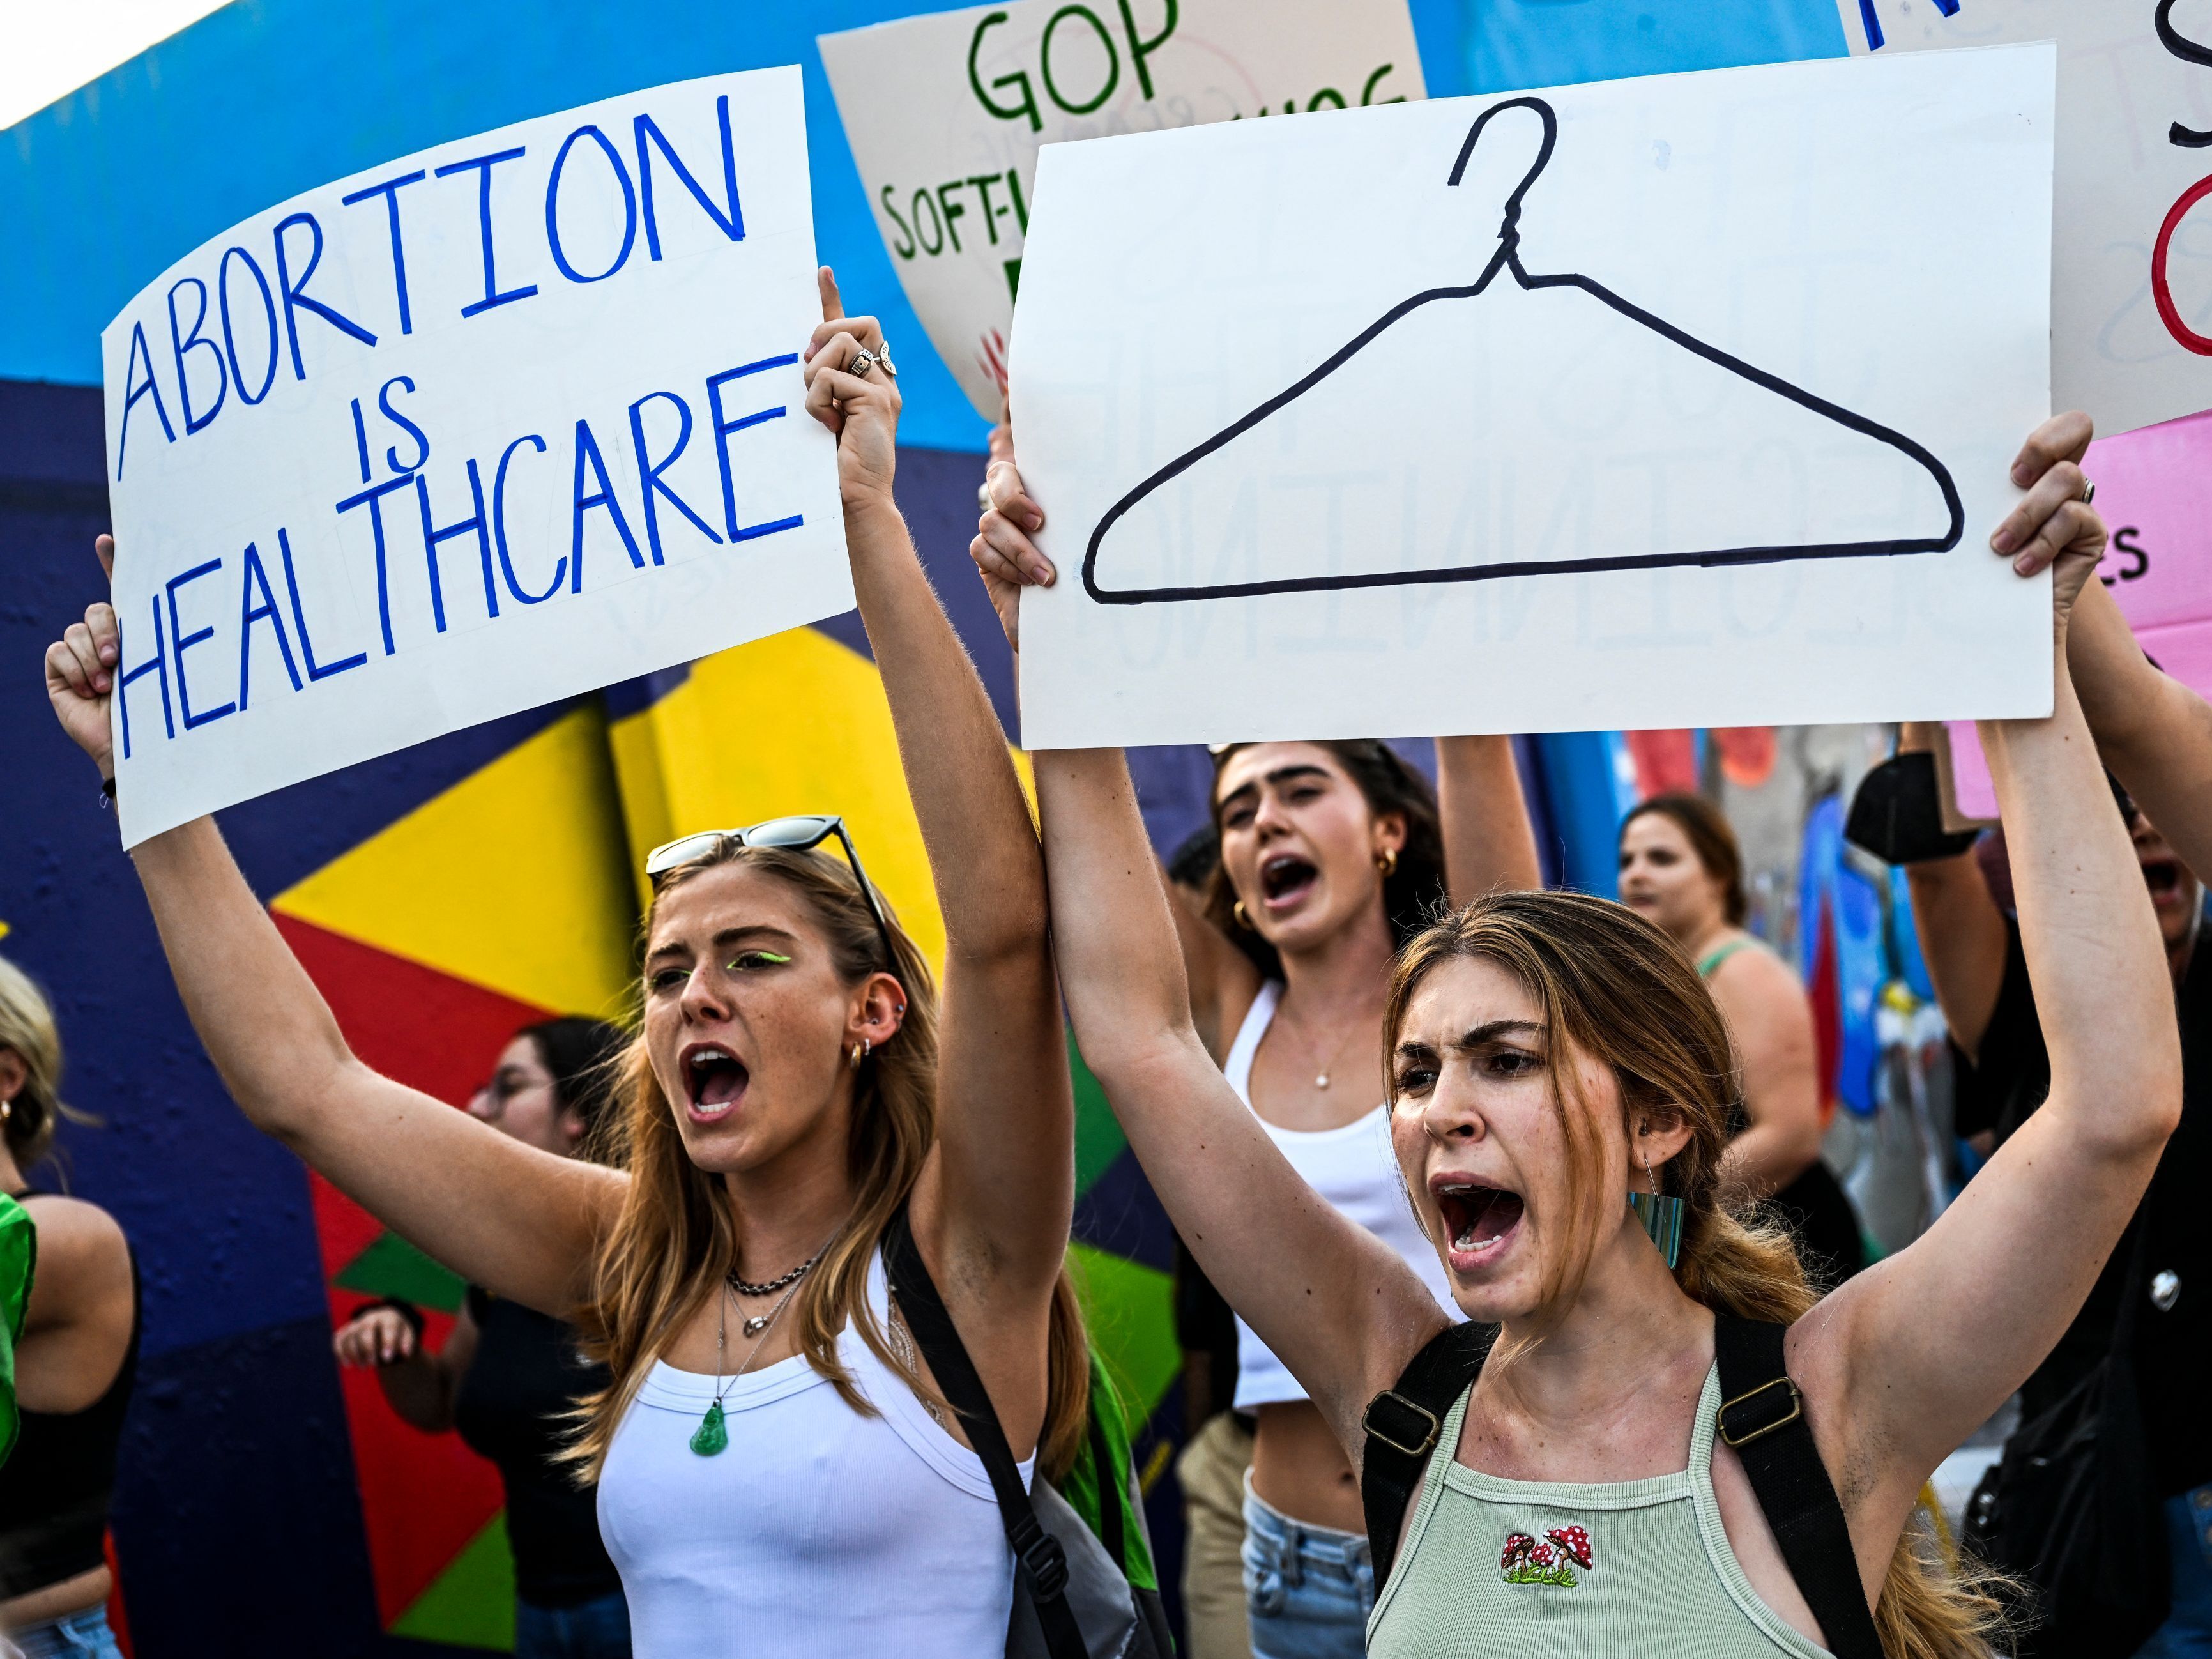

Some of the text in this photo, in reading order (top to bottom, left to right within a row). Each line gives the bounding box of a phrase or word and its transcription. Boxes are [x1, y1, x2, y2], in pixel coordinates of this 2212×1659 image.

[968, 0, 1179, 132] GOP
[117, 95, 745, 483] ABORTION
[117, 352, 805, 760] HEALTHCARE
[350, 375, 431, 484] IS
